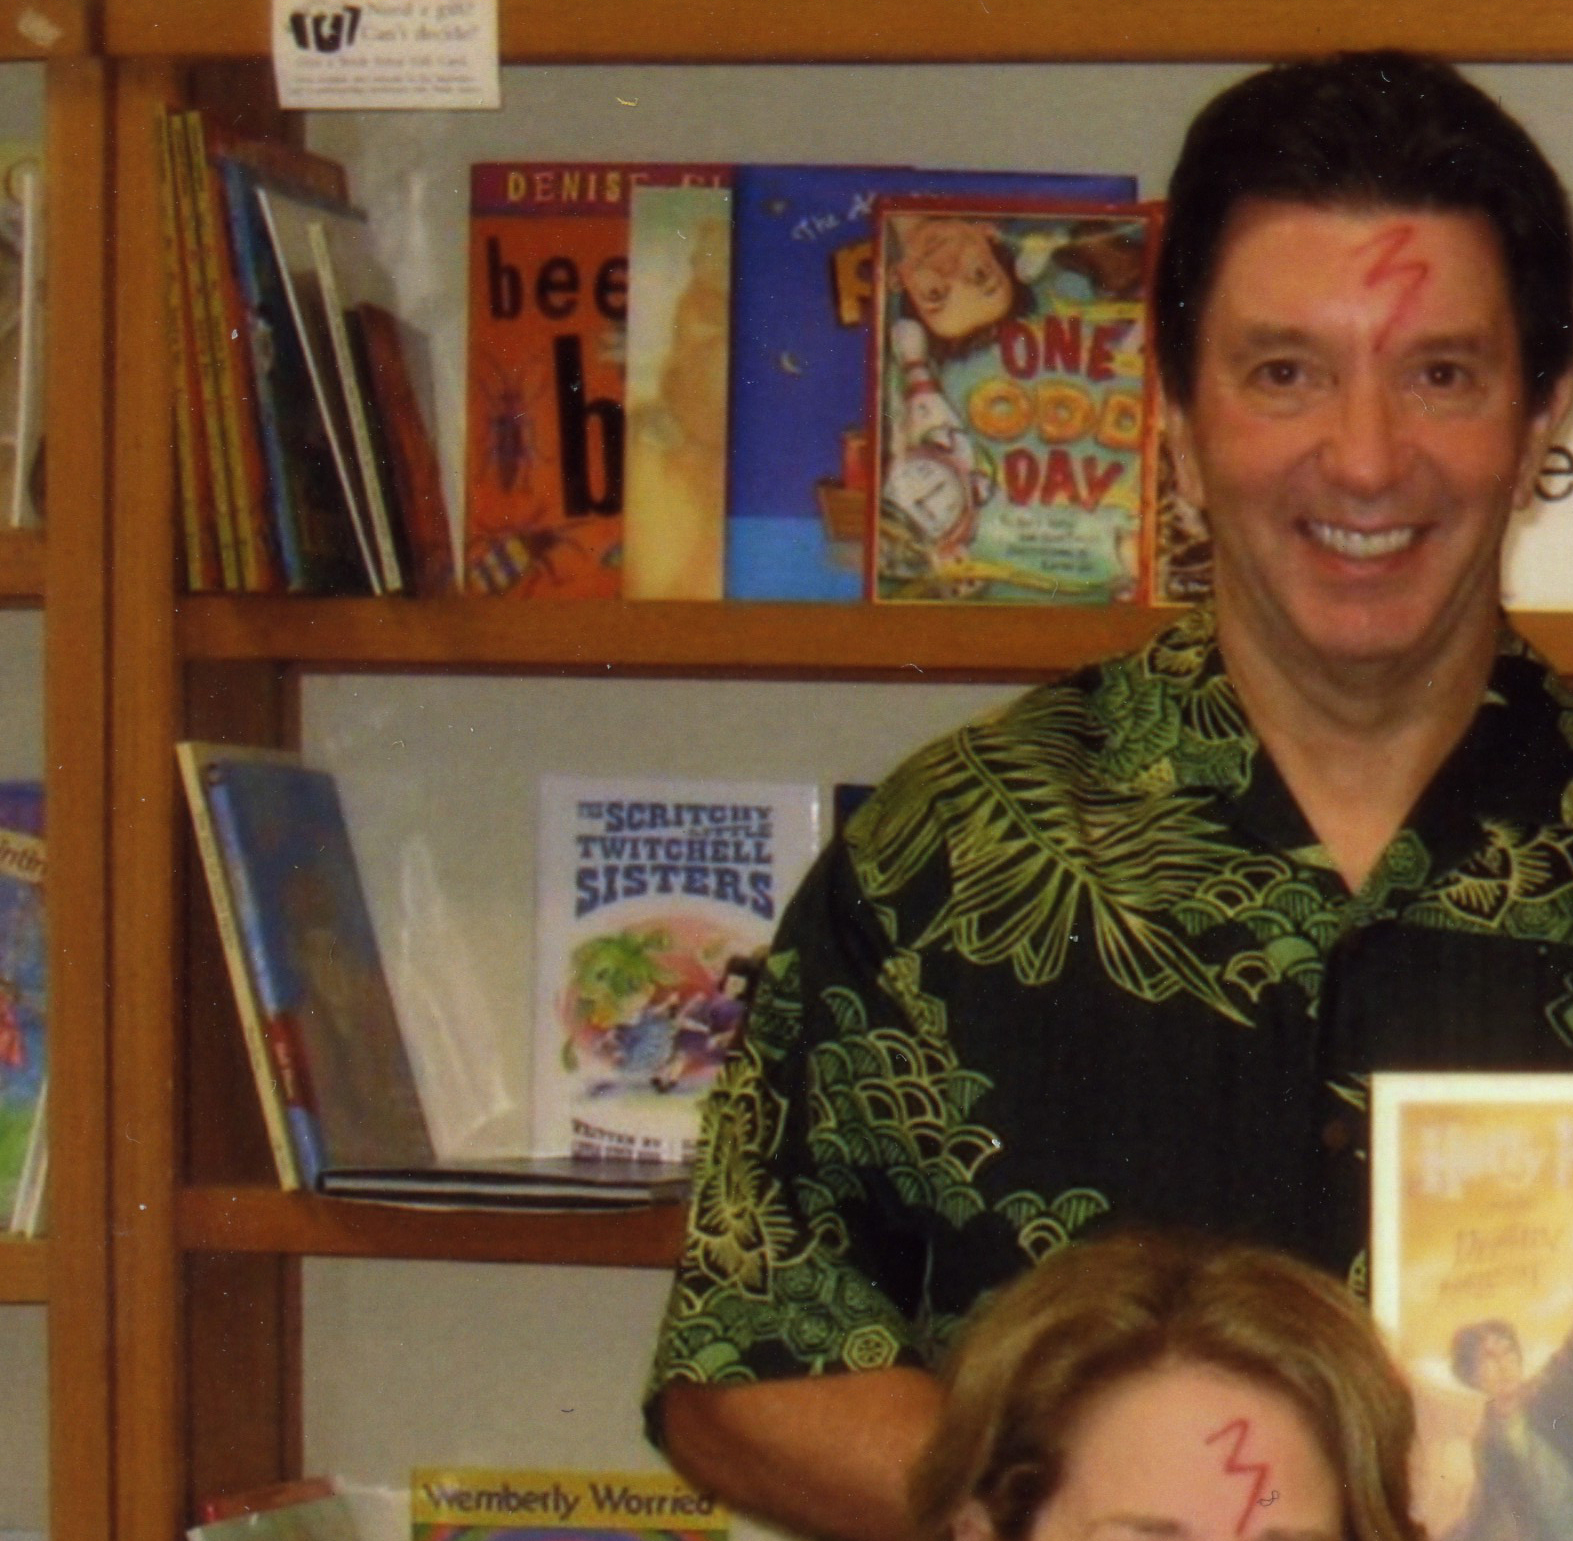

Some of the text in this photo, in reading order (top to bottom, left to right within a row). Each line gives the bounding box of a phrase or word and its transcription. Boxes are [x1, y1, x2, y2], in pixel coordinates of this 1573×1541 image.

[1000, 314, 1136, 381] ONE
[1004, 448, 1126, 512] DAY
[576, 833, 773, 864] TWITCHELL
[575, 862, 774, 921] SISTERS
[423, 1481, 717, 1521] Wemberly Worried
